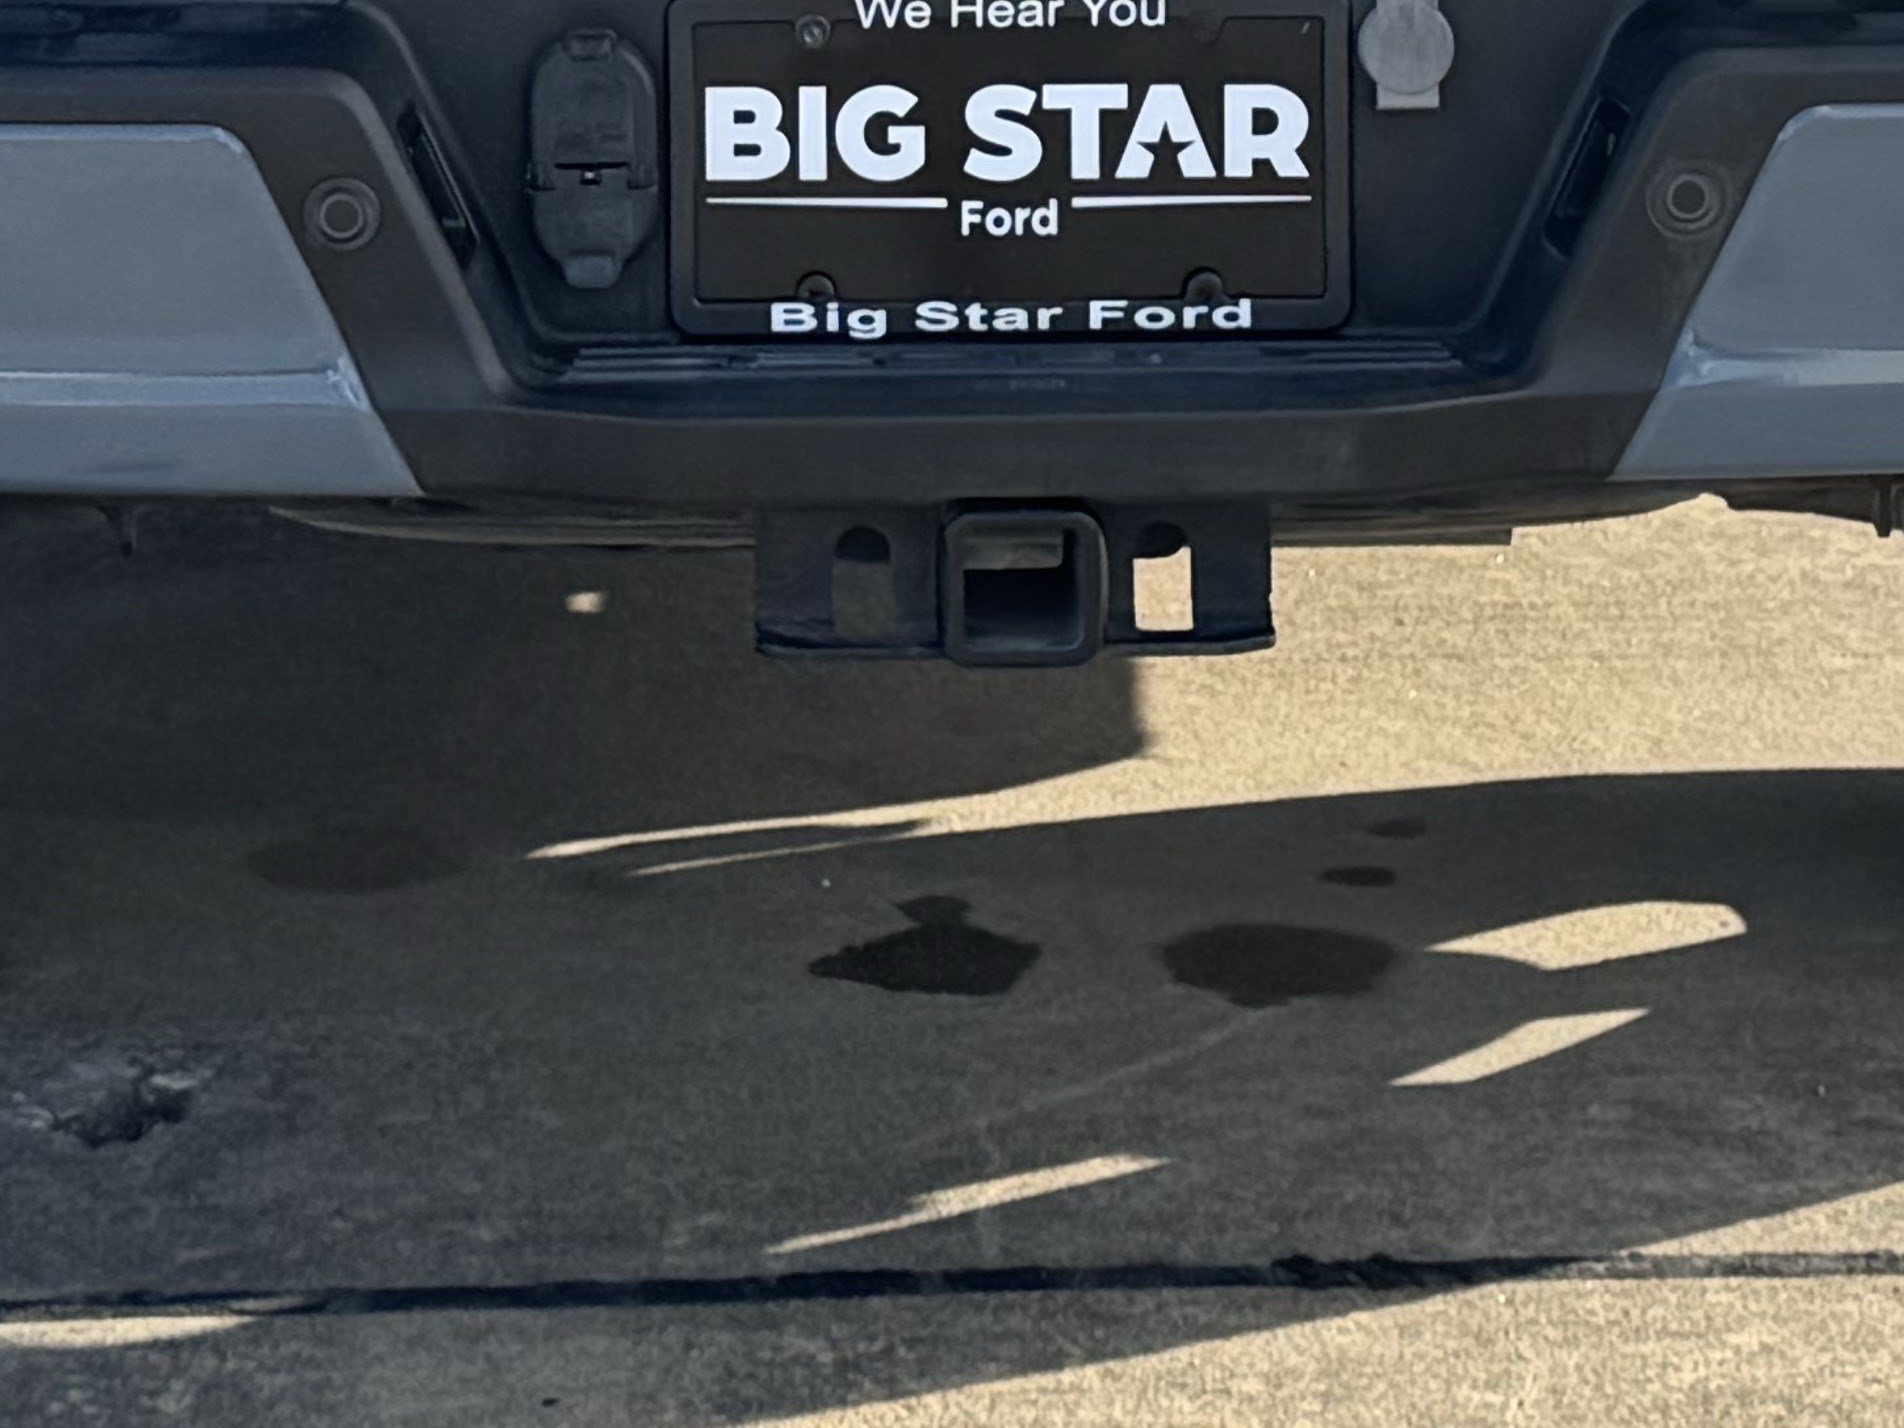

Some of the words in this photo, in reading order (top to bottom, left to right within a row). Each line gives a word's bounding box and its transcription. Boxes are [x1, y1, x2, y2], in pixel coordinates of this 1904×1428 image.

[703, 82, 927, 183] BIG
[963, 82, 1311, 182] STAR
[959, 196, 1060, 239] Ford
[768, 299, 889, 341] Big
[913, 299, 1066, 333] Star
[1087, 297, 1253, 332] Ford
